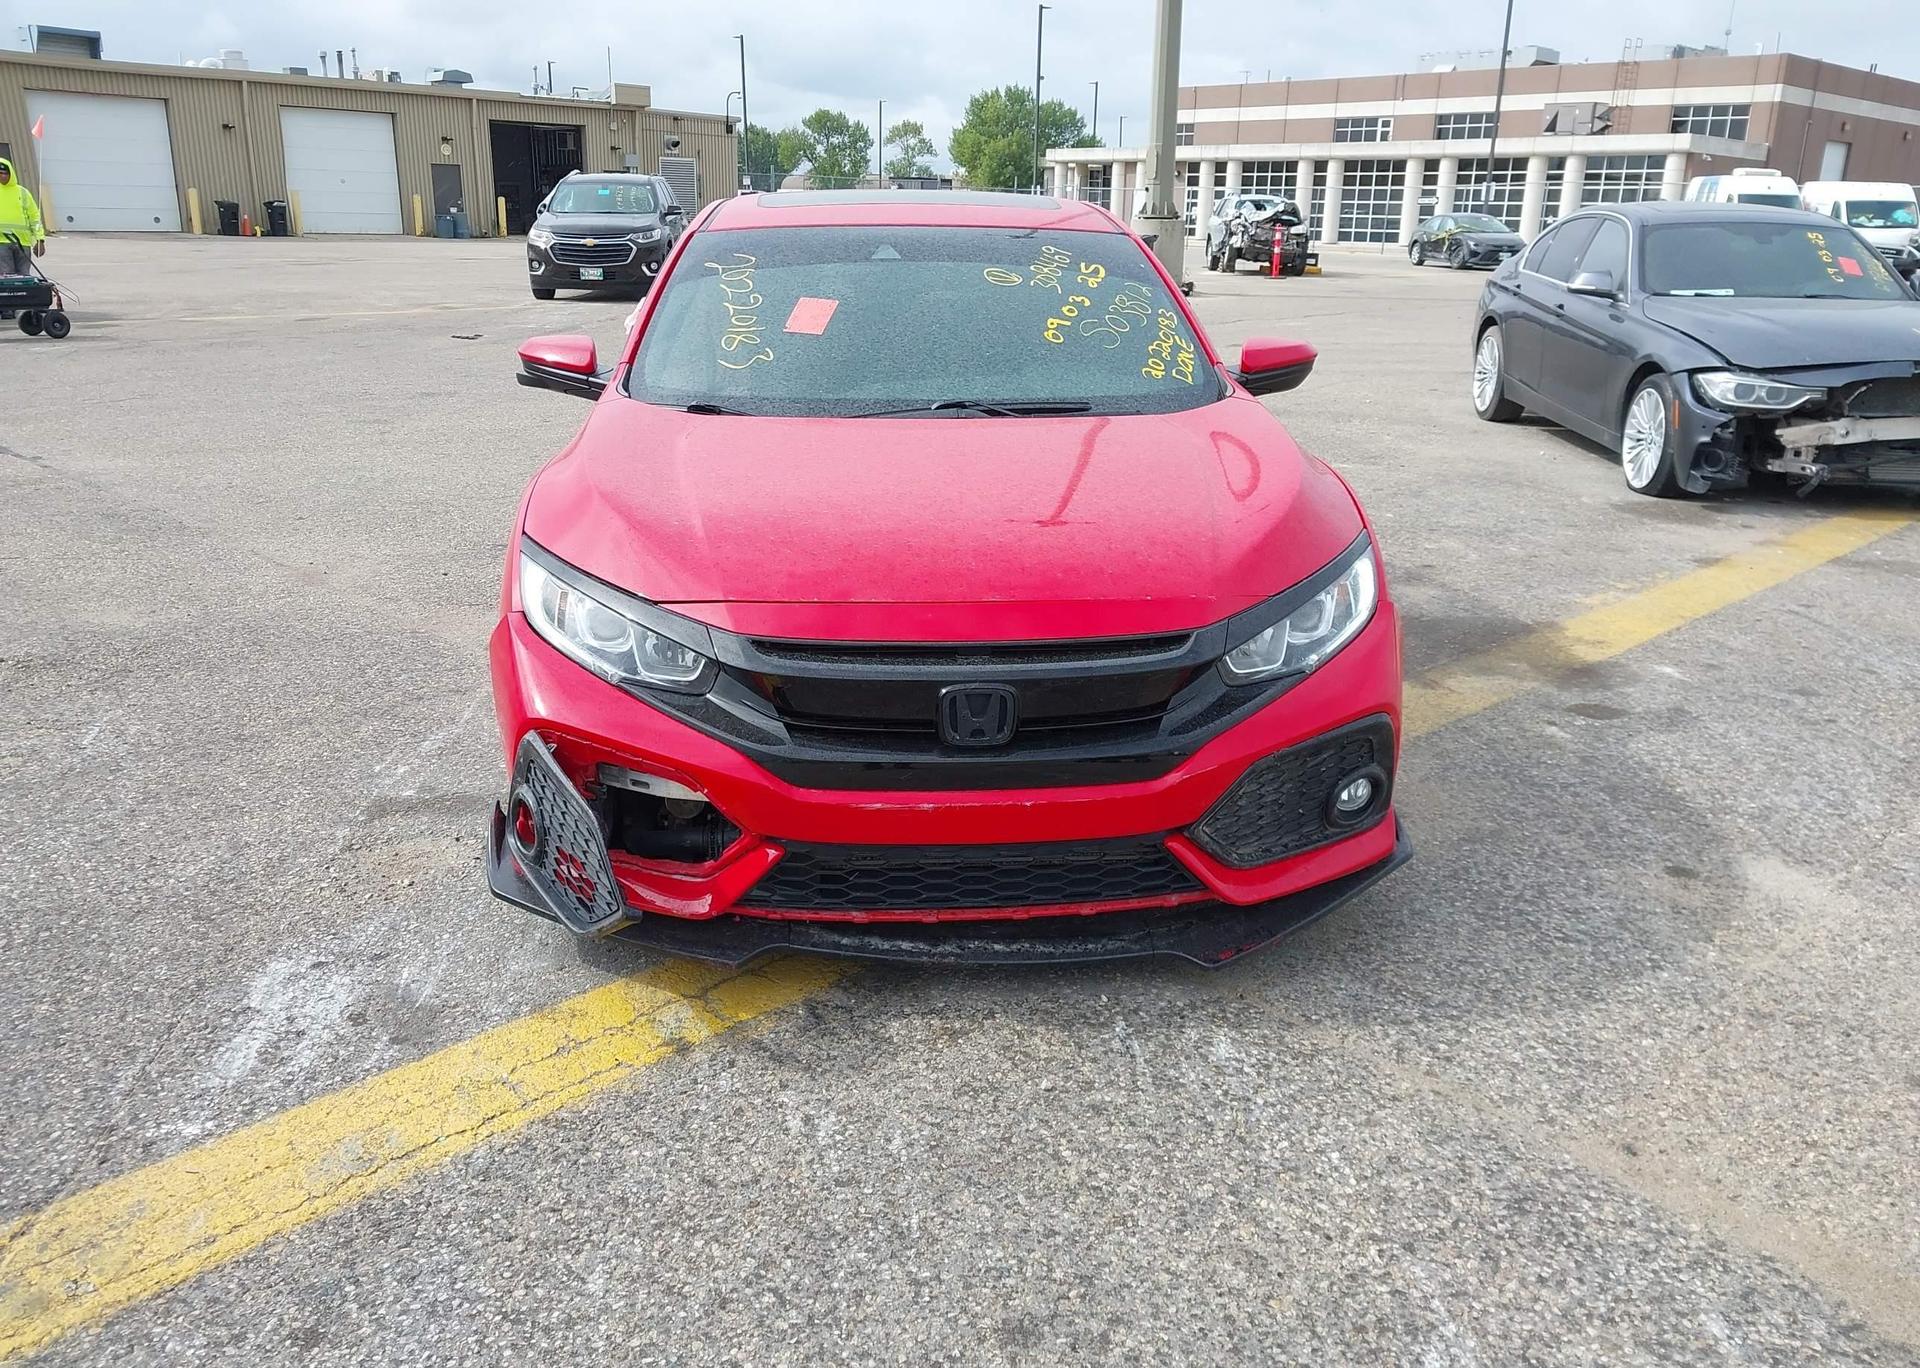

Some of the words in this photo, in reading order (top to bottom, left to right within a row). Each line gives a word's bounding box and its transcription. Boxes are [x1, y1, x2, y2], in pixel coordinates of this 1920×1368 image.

[1043, 317, 1072, 344] 09
[1061, 295, 1091, 317] 03
[1077, 261, 1106, 288] 25
